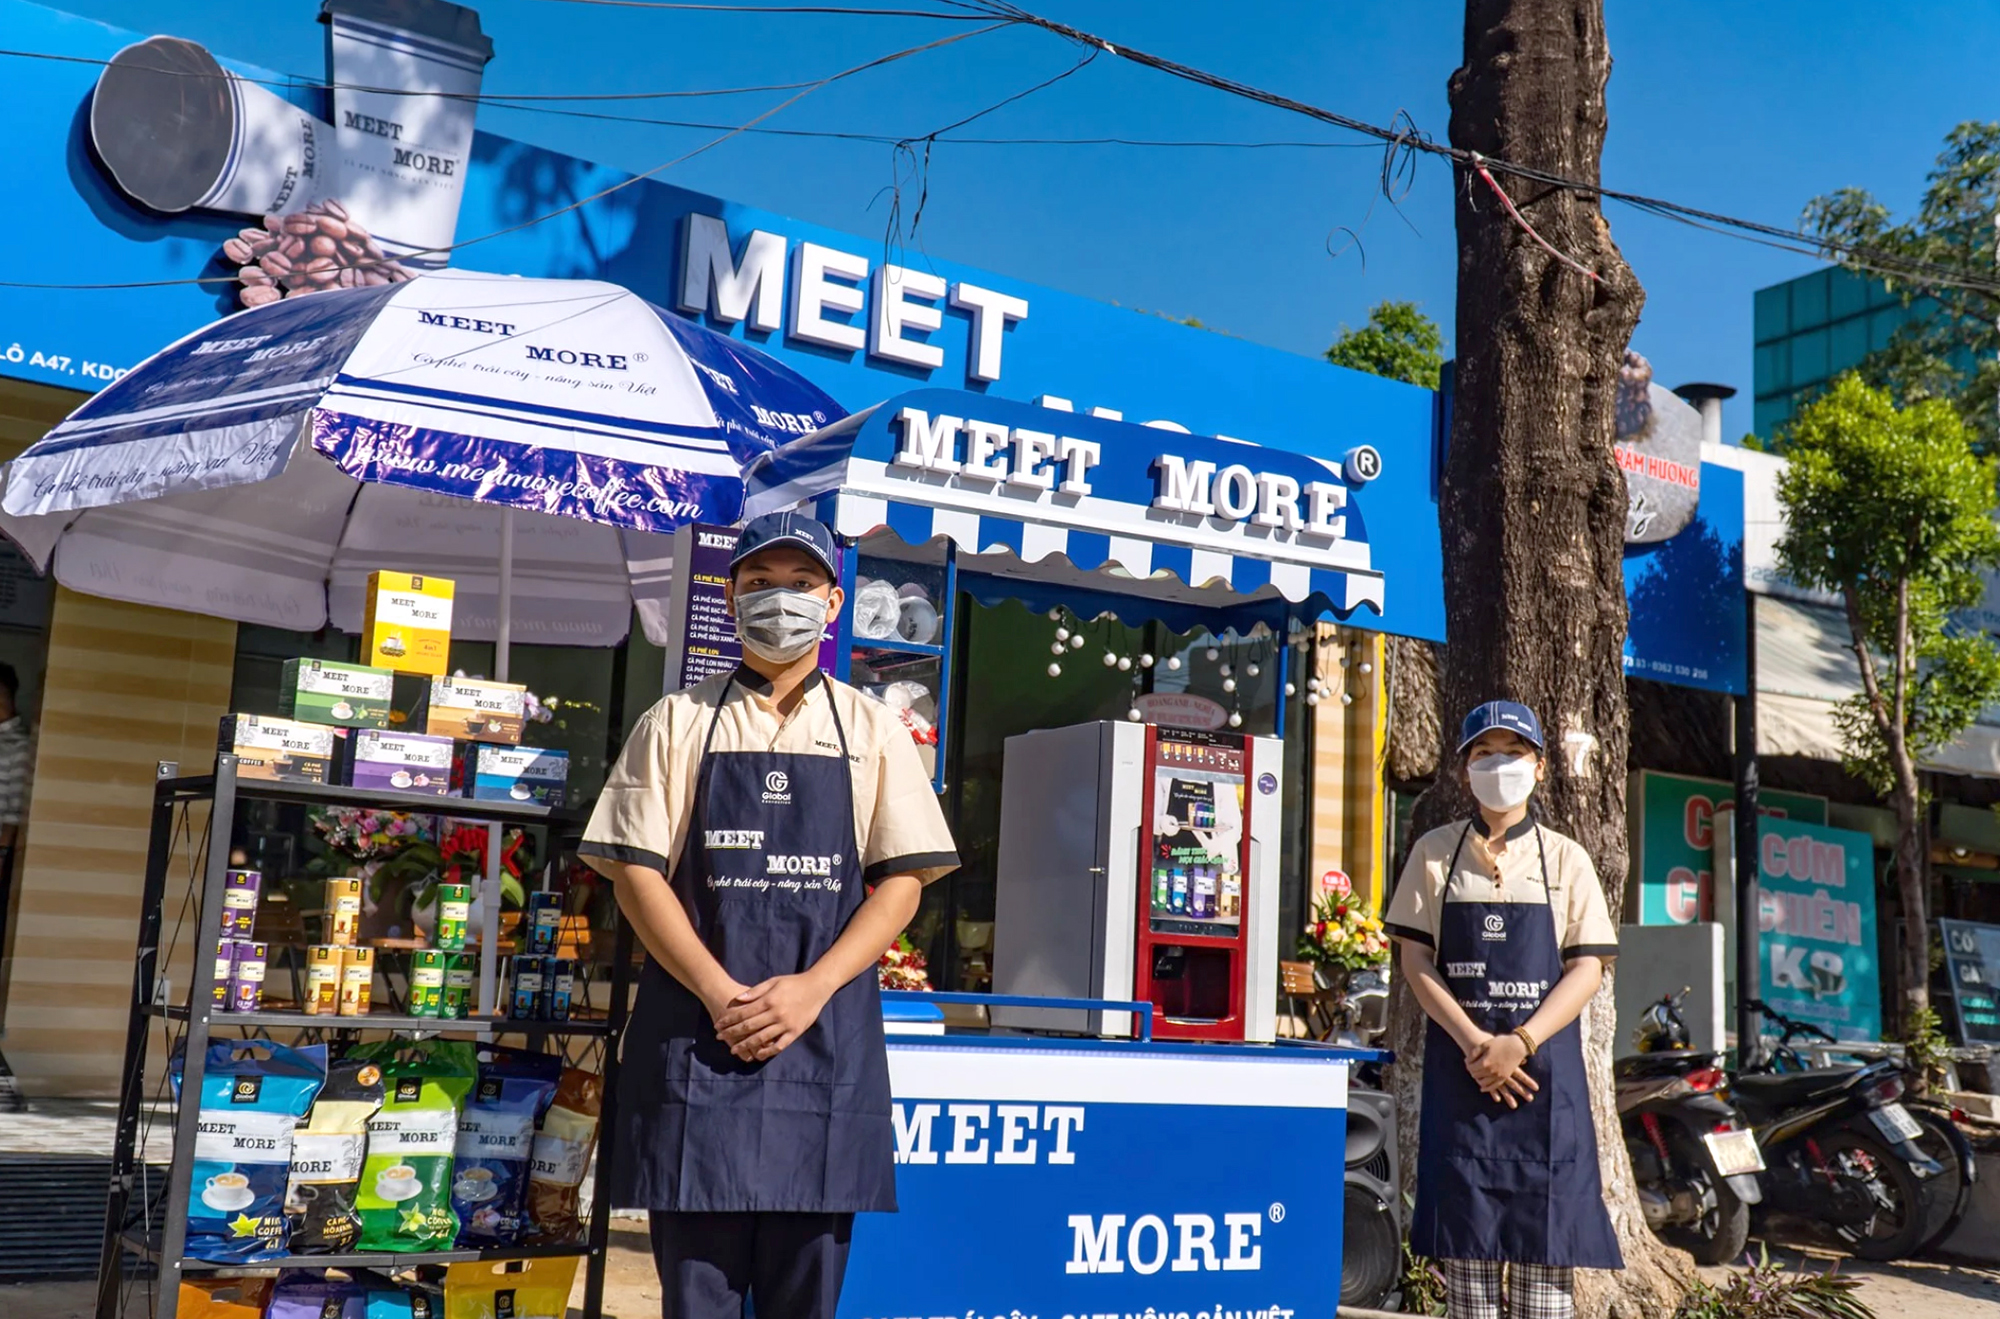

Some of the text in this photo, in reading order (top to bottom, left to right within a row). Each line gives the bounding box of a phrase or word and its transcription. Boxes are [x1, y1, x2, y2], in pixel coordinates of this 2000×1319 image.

[344, 110, 403, 141] MEET
[300, 117, 315, 179] MORE
[393, 147, 456, 177] MORE
[265, 166, 299, 214] MEET
[677, 212, 1029, 382] MEET
[418, 311, 516, 337] MEET
[190, 334, 273, 355] MEET
[243, 336, 328, 363] MORE
[29, 351, 75, 375] A47,
[525, 345, 628, 371] MORE
[750, 404, 818, 434] MORE
[894, 406, 1101, 496] MEET
[1153, 454, 1347, 539] MORE
[391, 598, 416, 607] MEET
[412, 609, 437, 619] MORE
[323, 671, 349, 682] MEET
[342, 684, 370, 694] MORE
[455, 687, 481, 697] MEET
[474, 699, 502, 710] MORE
[262, 726, 289, 737] MEET
[281, 739, 310, 750] MORE
[380, 742, 405, 752] MEET
[815, 739, 837, 750] MEET
[239, 758, 262, 767] COFFEE
[404, 753, 430, 763] MORE
[1564, 733, 1597, 776] 7
[762, 790, 791, 801] Global
[705, 830, 764, 849] MEET
[766, 855, 831, 876] MORE
[1762, 832, 1846, 888] CƠM
[1759, 888, 1862, 946] CHIÊN
[1446, 962, 1486, 978] MEET
[1488, 981, 1540, 998] MORE
[197, 1123, 236, 1135] MEET
[367, 1122, 400, 1132] MEET
[459, 1122, 481, 1132] EET
[891, 1103, 1085, 1166] MEET
[233, 1137, 276, 1150] MORE
[399, 1133, 438, 1143] MORE
[478, 1136, 516, 1147] MORE
[530, 1160, 556, 1174] ORE
[1065, 1212, 1262, 1275] MORE
